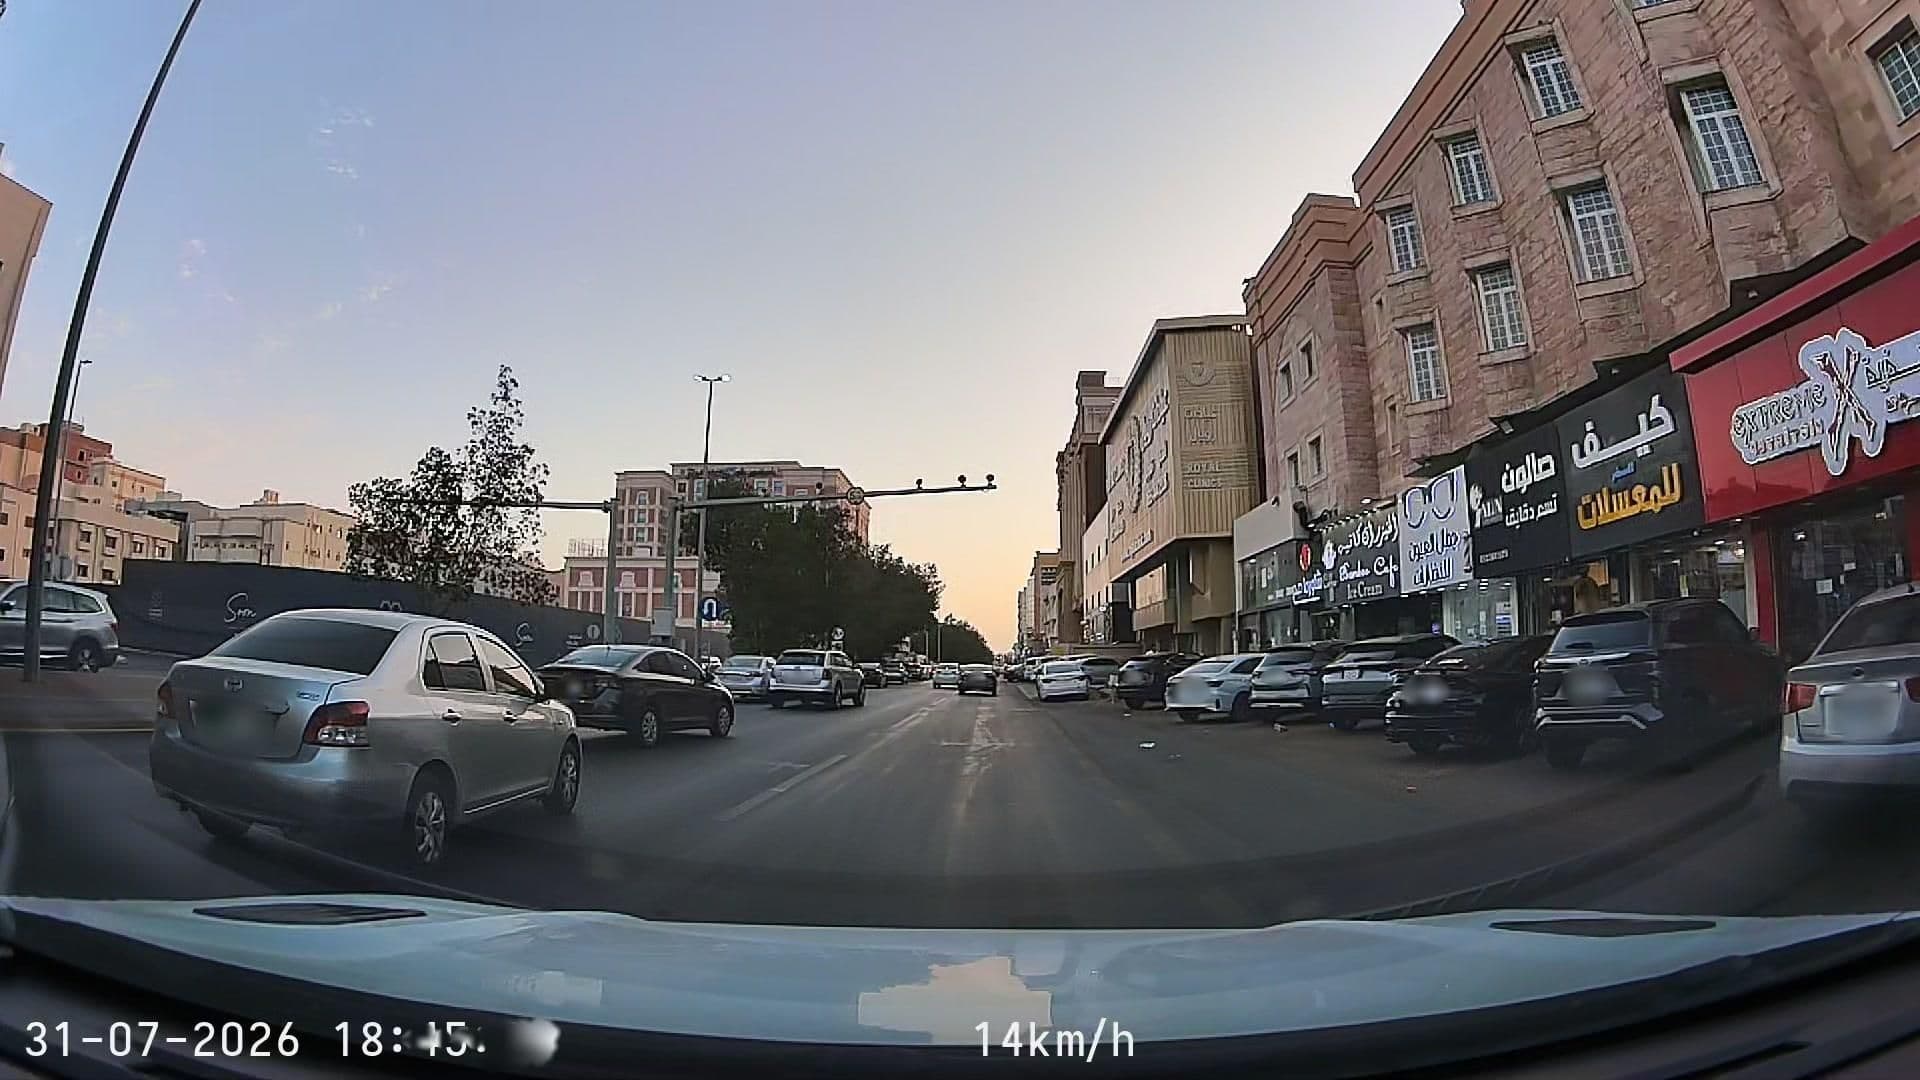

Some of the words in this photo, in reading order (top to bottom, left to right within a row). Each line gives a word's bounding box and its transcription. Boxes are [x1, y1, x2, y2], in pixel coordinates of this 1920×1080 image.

[1572, 394, 1676, 468] كيف
[1502, 452, 1556, 493] صالون
[1577, 462, 1682, 530] للمعسلات
[1347, 583, 1357, 600] Ice
[1358, 581, 1384, 598] Cream
